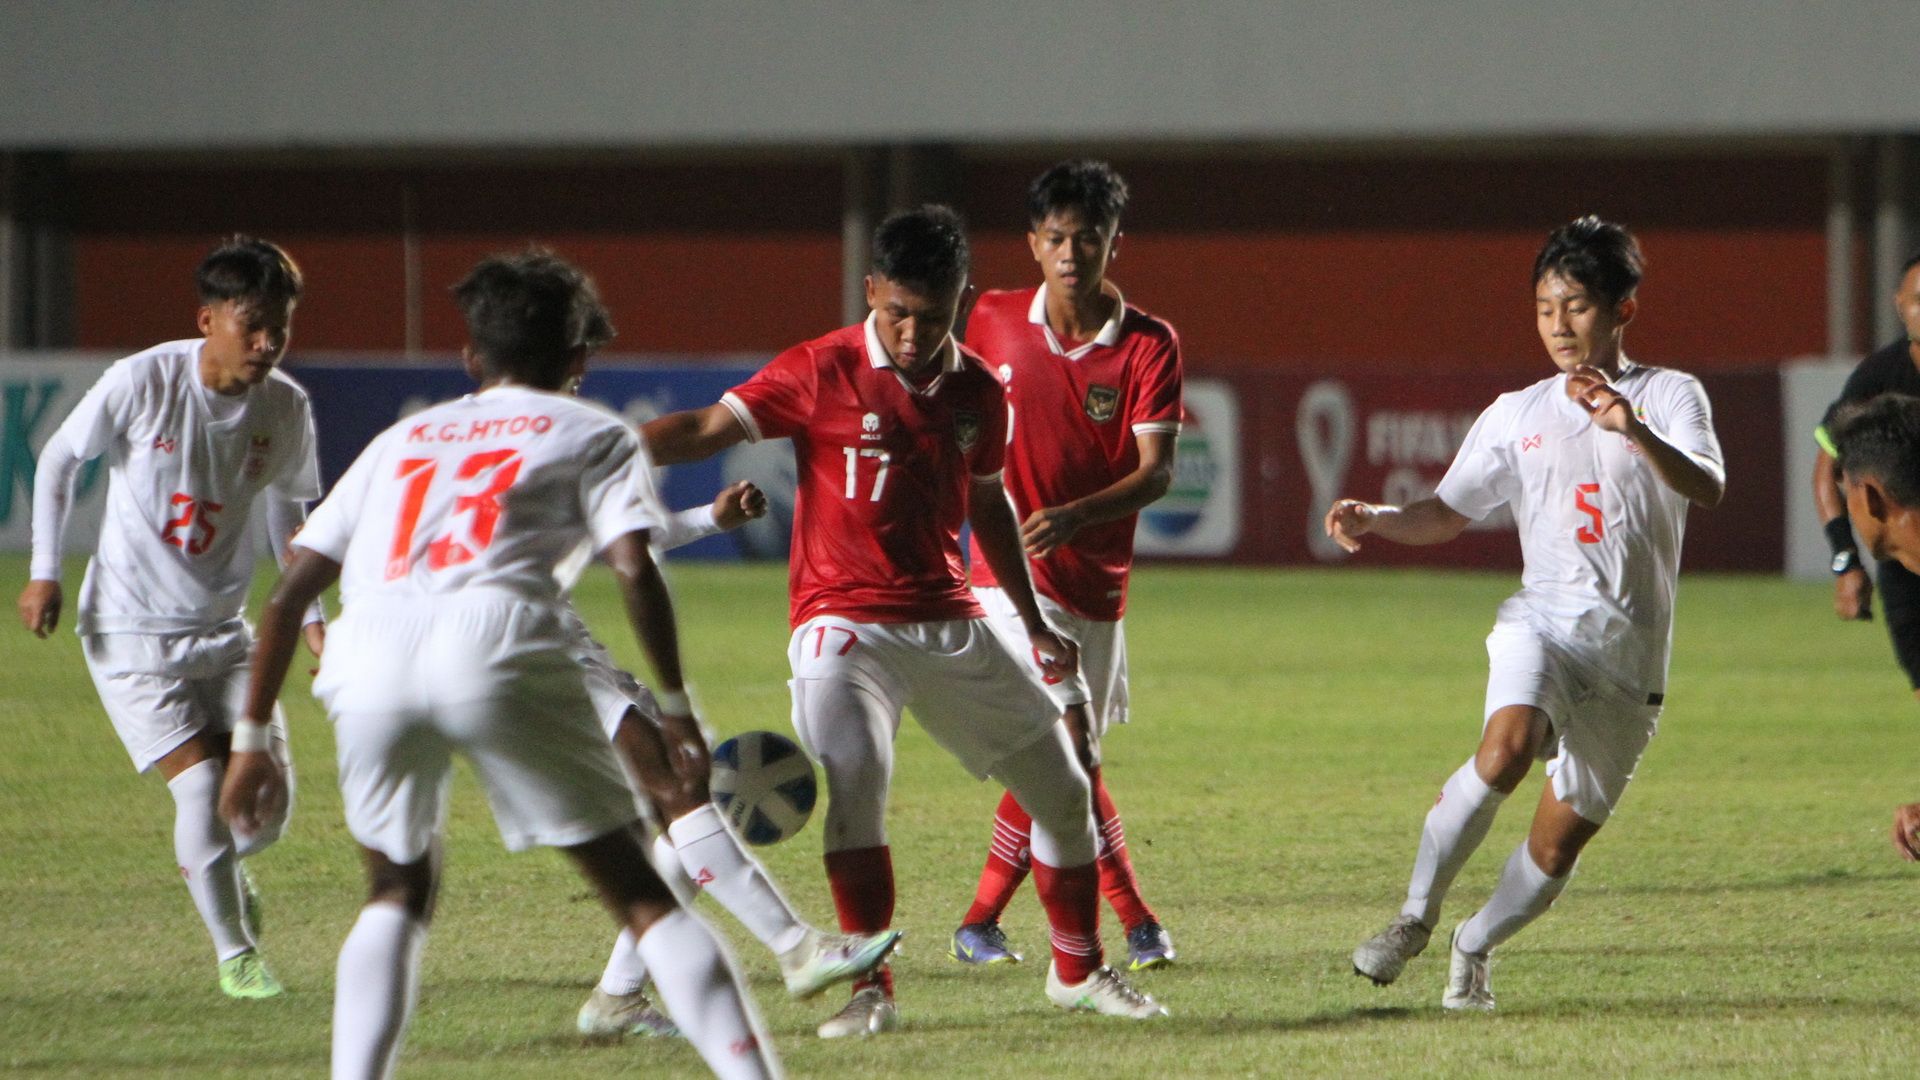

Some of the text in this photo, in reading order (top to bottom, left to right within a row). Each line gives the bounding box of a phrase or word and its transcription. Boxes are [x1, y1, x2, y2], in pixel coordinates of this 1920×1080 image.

[843, 447, 890, 502] 17
[161, 493, 223, 555] 25
[385, 449, 524, 581] 13
[1575, 483, 1603, 543] 5
[813, 626, 858, 658] 17
